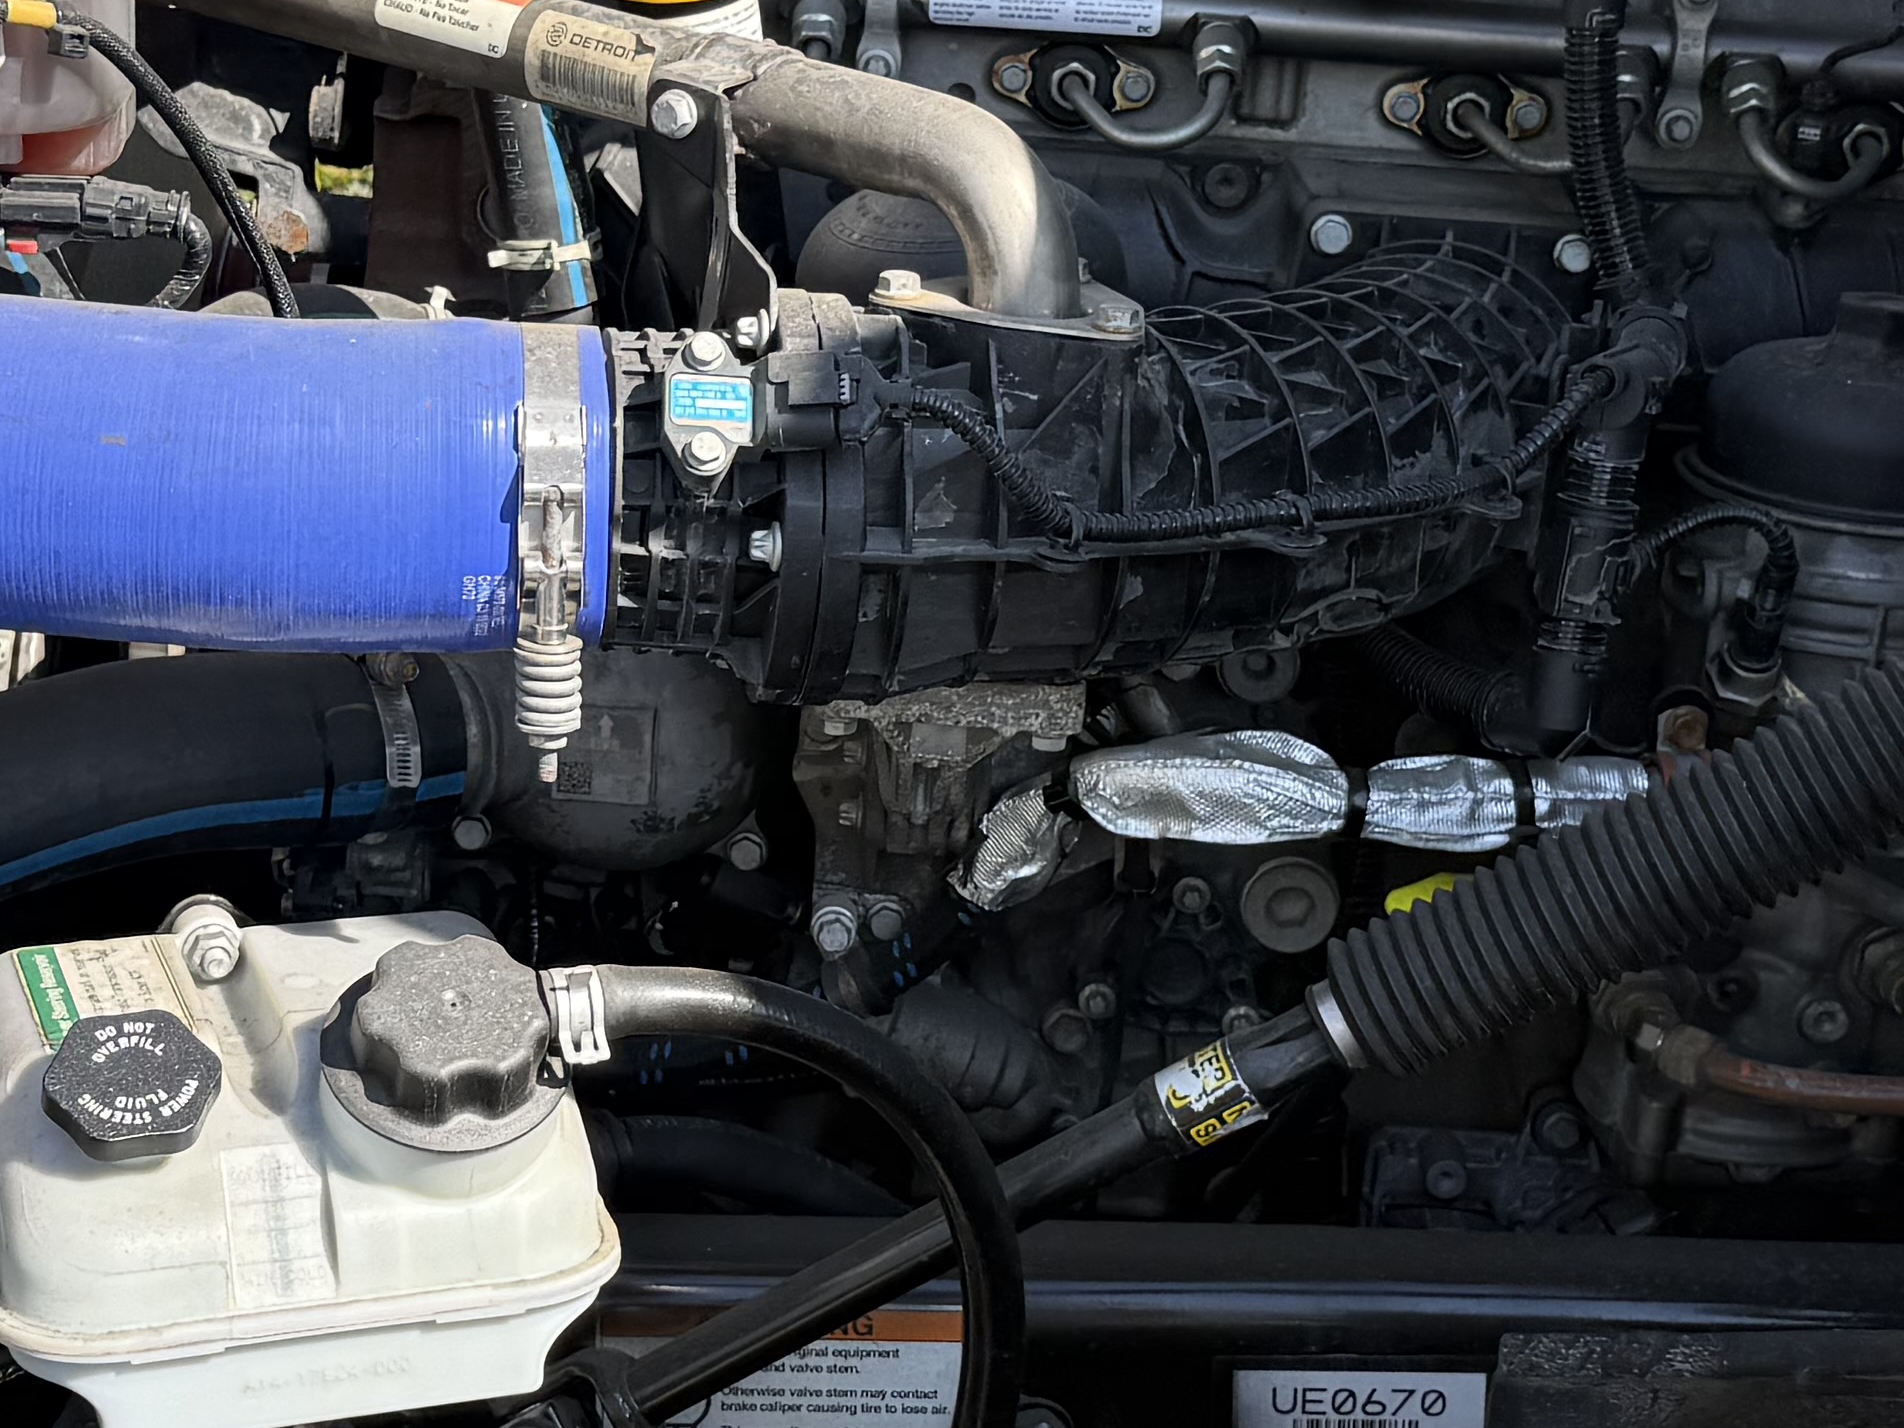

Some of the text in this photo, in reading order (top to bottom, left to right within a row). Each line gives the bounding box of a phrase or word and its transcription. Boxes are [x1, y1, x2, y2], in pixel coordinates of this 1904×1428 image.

[499, 139, 529, 200] MADE
[94, 1022, 155, 1042] DO NOT
[91, 1035, 166, 1063] OVERFILL
[77, 1079, 199, 1125] POWER STEERING
[115, 1088, 169, 1109] FLUID
[832, 1348, 900, 1360] equipment
[789, 1364, 824, 1374] valve
[826, 1364, 860, 1374] stem.
[721, 1386, 938, 1401] Otherwise valve stem may contact
[1271, 1387, 1447, 1417] UE0670
[720, 1401, 951, 1416] brake caliper causing tire to lose air.
